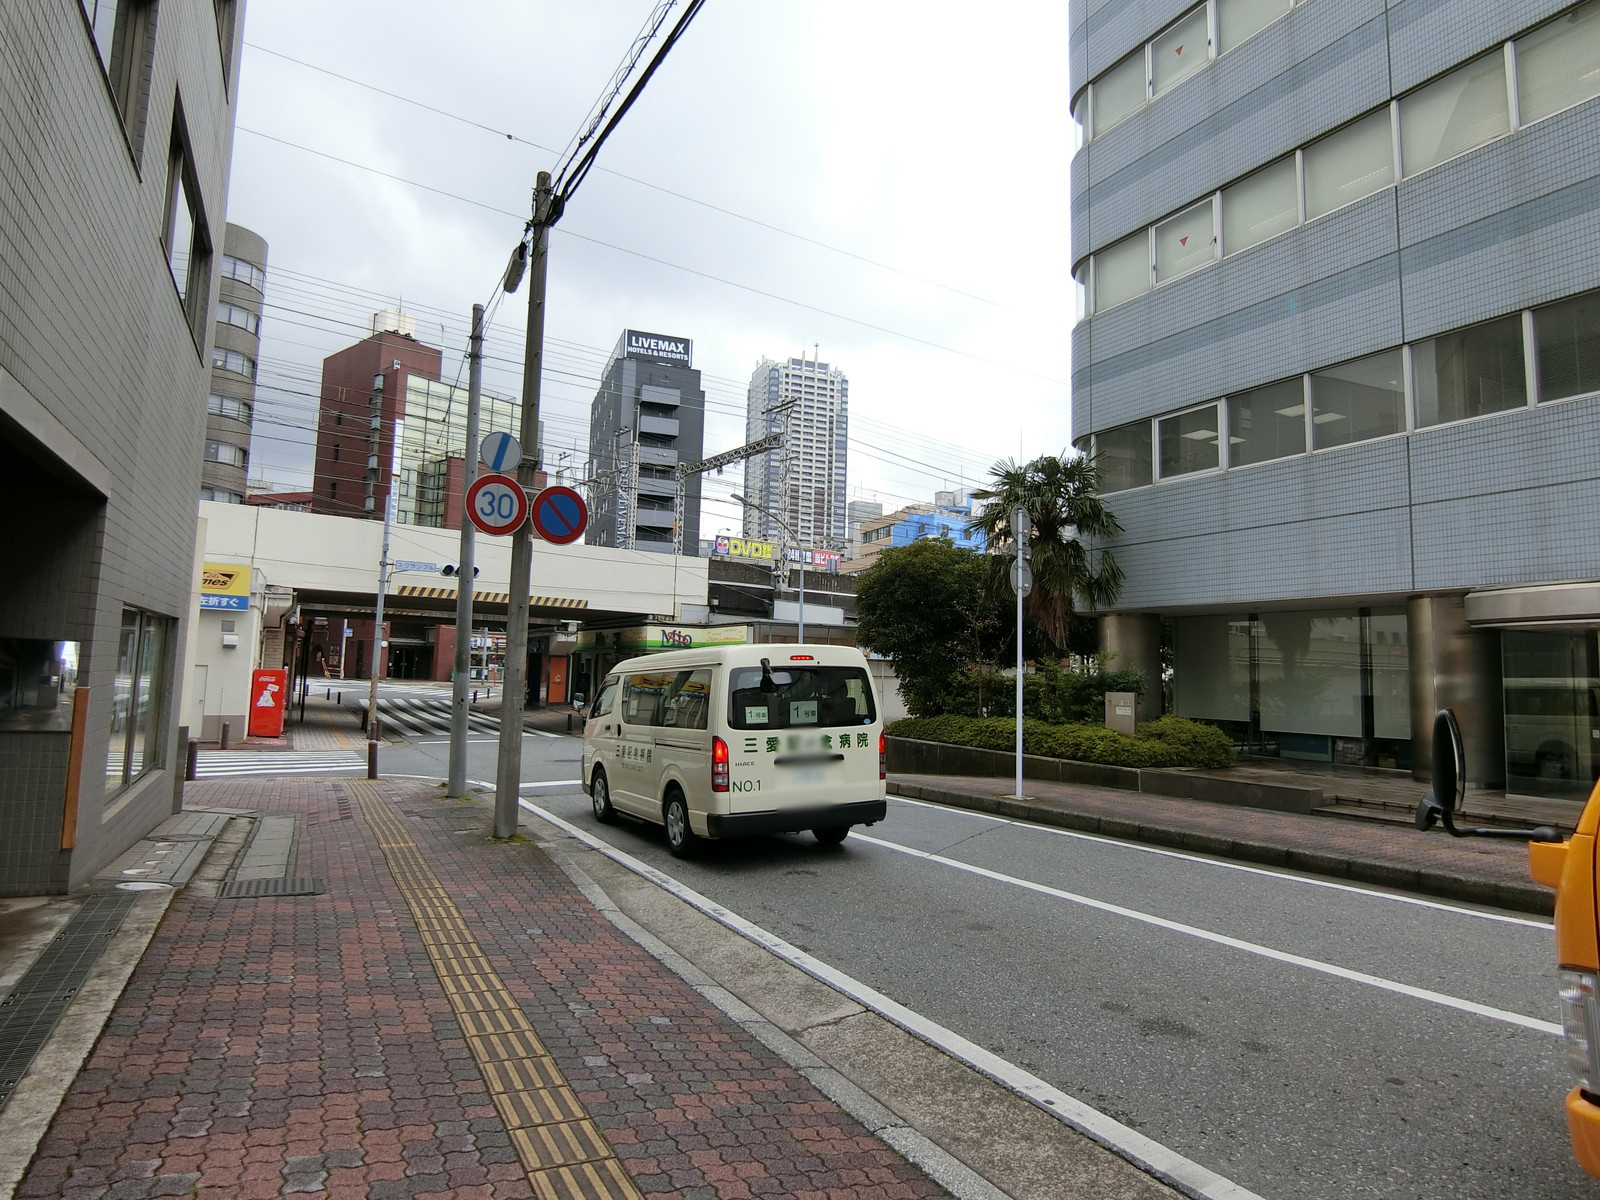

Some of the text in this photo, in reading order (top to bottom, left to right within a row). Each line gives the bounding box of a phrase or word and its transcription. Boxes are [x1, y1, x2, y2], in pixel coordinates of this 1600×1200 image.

[628, 346, 652, 356] HOTELS
[659, 352, 688, 361] RESORTS
[480, 491, 514, 519] 30
[200, 596, 239, 607] 左折すぐ
[661, 630, 692, 648] Mio
[732, 780, 761, 793] NO.1
